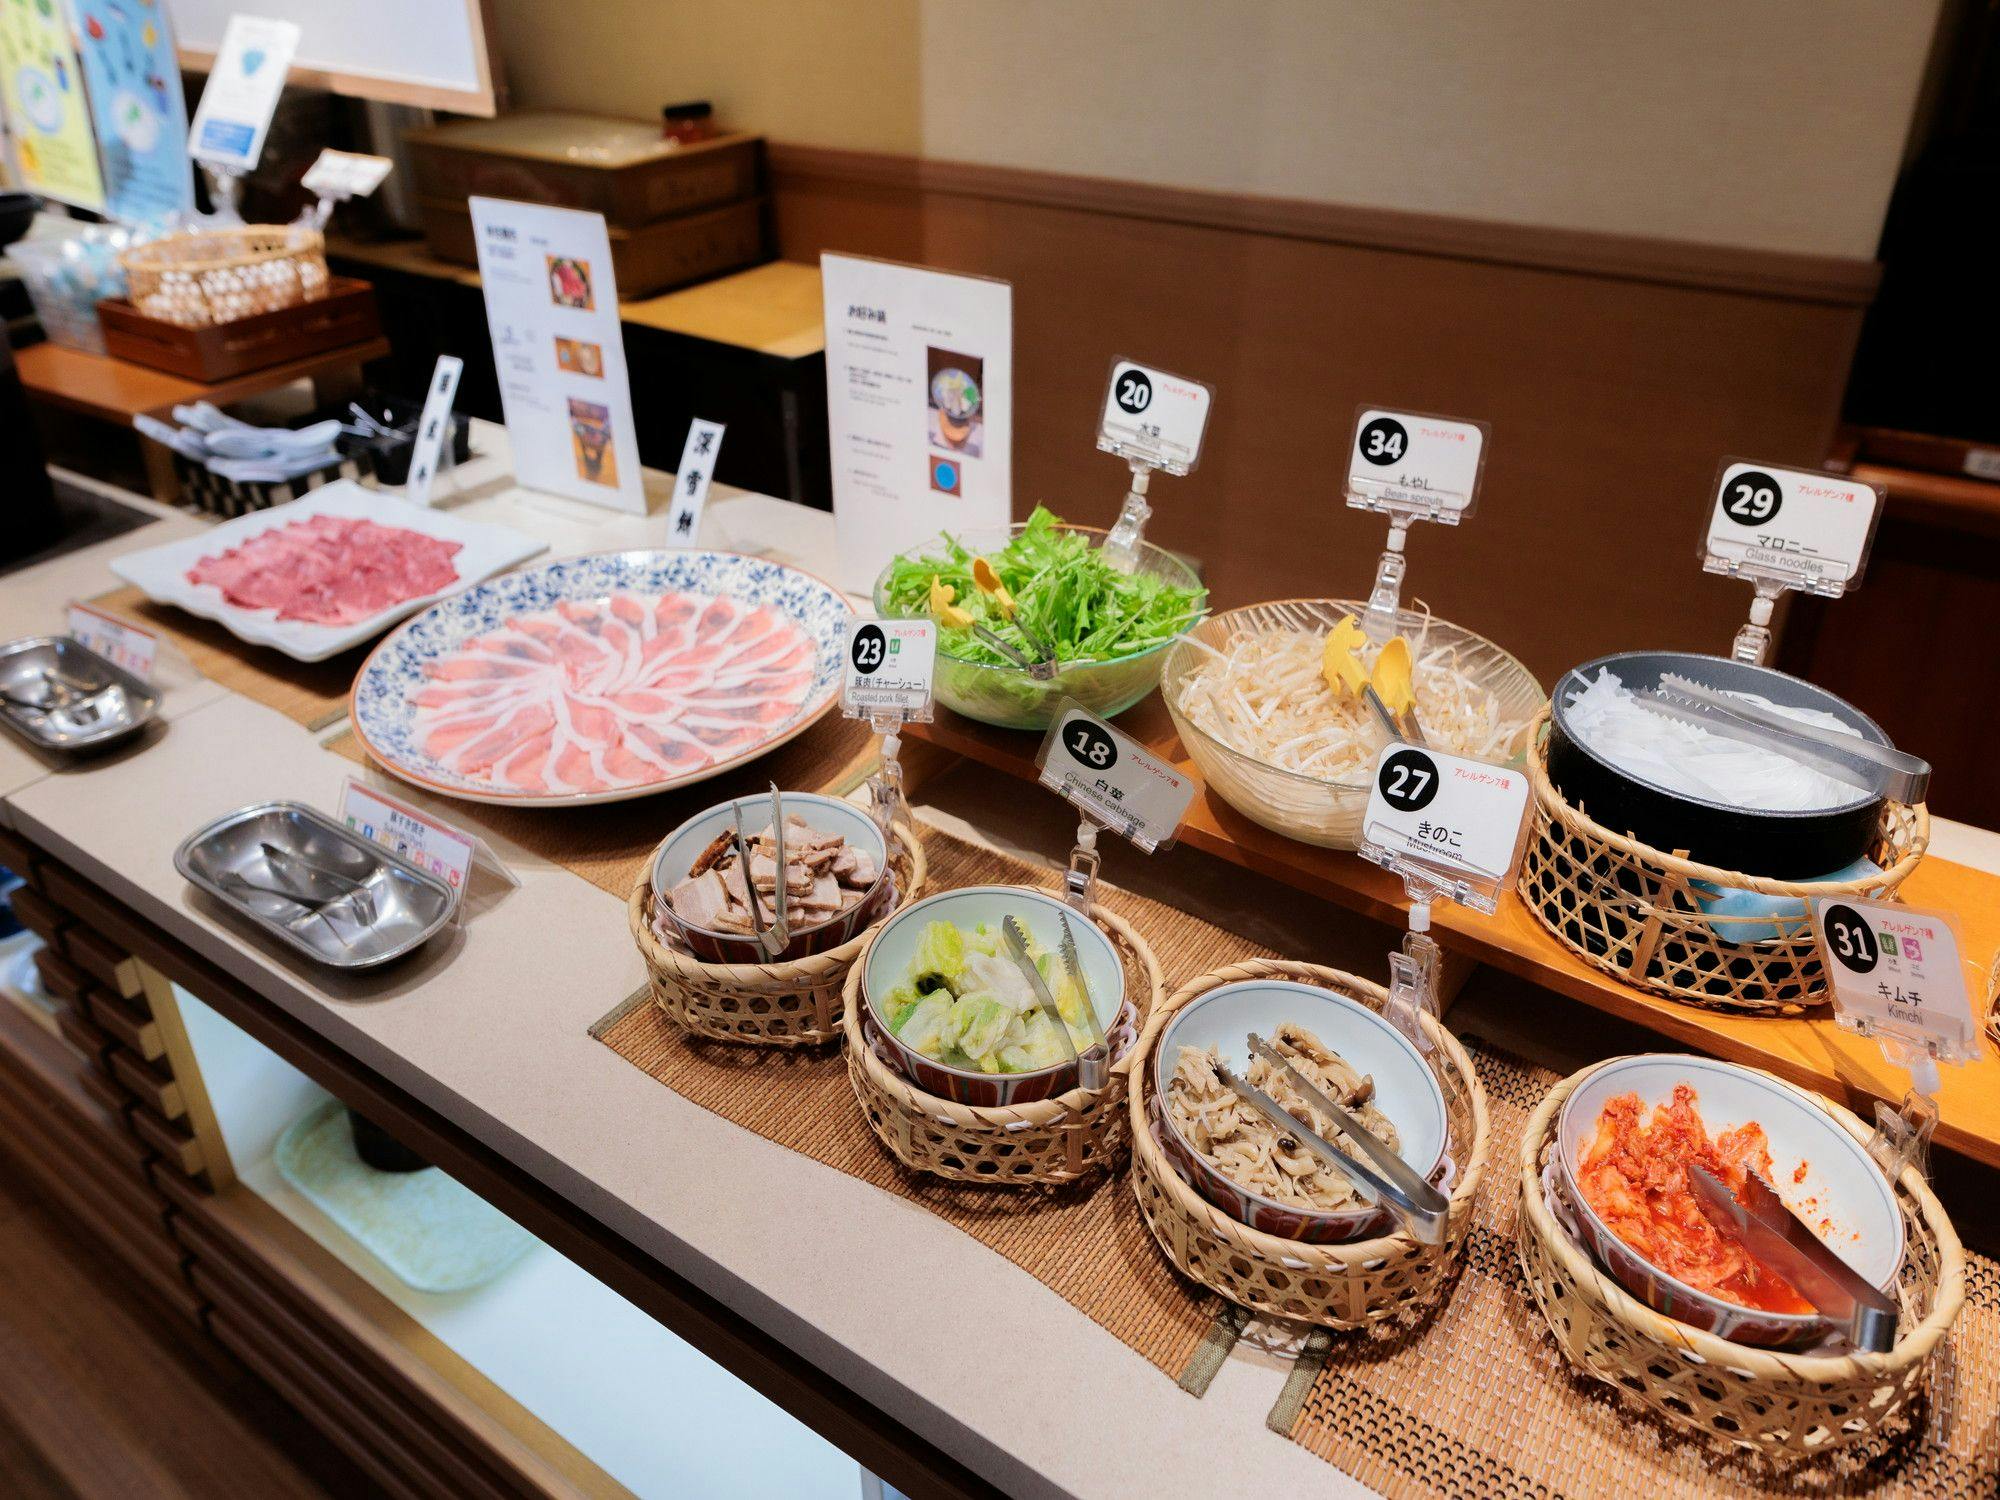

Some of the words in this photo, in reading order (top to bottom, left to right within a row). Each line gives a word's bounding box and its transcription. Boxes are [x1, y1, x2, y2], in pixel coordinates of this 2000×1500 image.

[1119, 379, 1150, 410] 20
[1367, 429, 1403, 460] 34
[1399, 474, 1433, 491] もやし
[1384, 487, 1408, 500] Bean
[1410, 492, 1445, 507] sprouts
[1730, 484, 1775, 519] 29
[1757, 533, 1819, 553] マロニー
[1744, 548, 1777, 565] Glass
[1779, 554, 1825, 574] noodles
[856, 637, 882, 665] 23
[851, 691, 878, 702] Roasted
[879, 693, 894, 704] pork
[1071, 731, 1110, 766] 18
[1130, 753, 1181, 789] アレルゲン7種
[1387, 764, 1432, 801] 27
[1454, 767, 1512, 790] アレルゲン7種
[1064, 771, 1104, 803] Chinese
[1104, 799, 1146, 829] cabbage
[1094, 778, 1126, 802] 白菜
[1417, 820, 1463, 848] きのこ
[1834, 922, 1873, 962] 31
[1877, 981, 1923, 1007] キムチ
[1887, 1003, 1924, 1026] Kimchi
